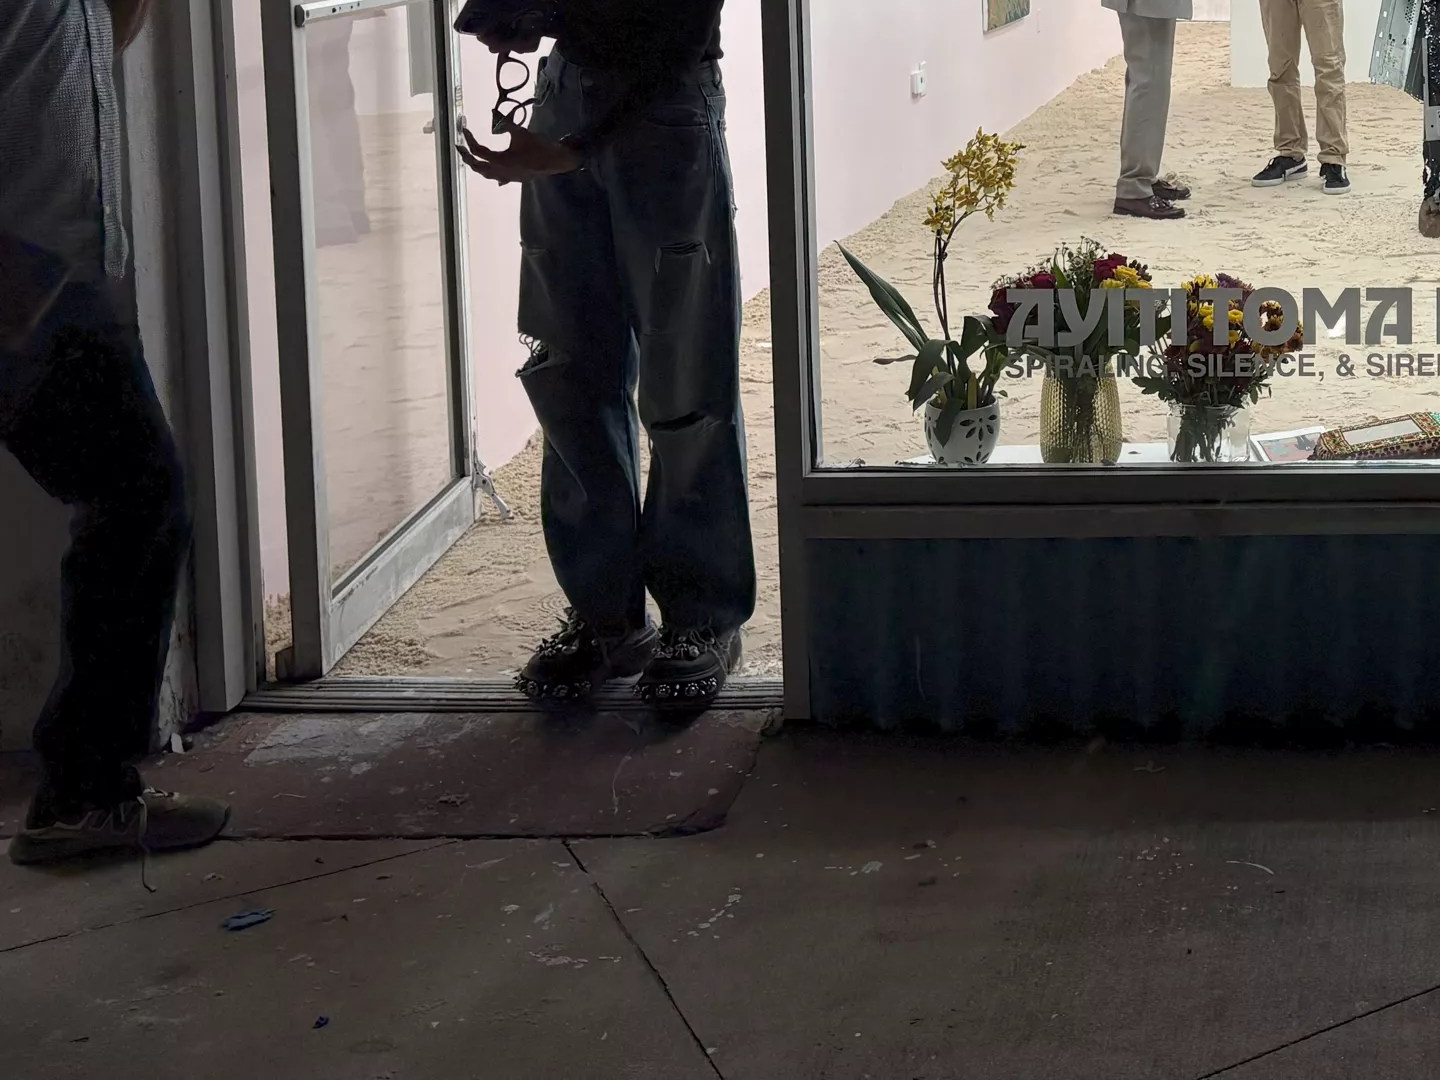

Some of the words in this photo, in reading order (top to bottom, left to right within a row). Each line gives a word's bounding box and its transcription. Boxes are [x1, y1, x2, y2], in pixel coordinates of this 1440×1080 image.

[1005, 286, 1413, 348] AYITITOMA
[1187, 353, 1325, 382] SILENCE,
[1335, 353, 1355, 378] &
